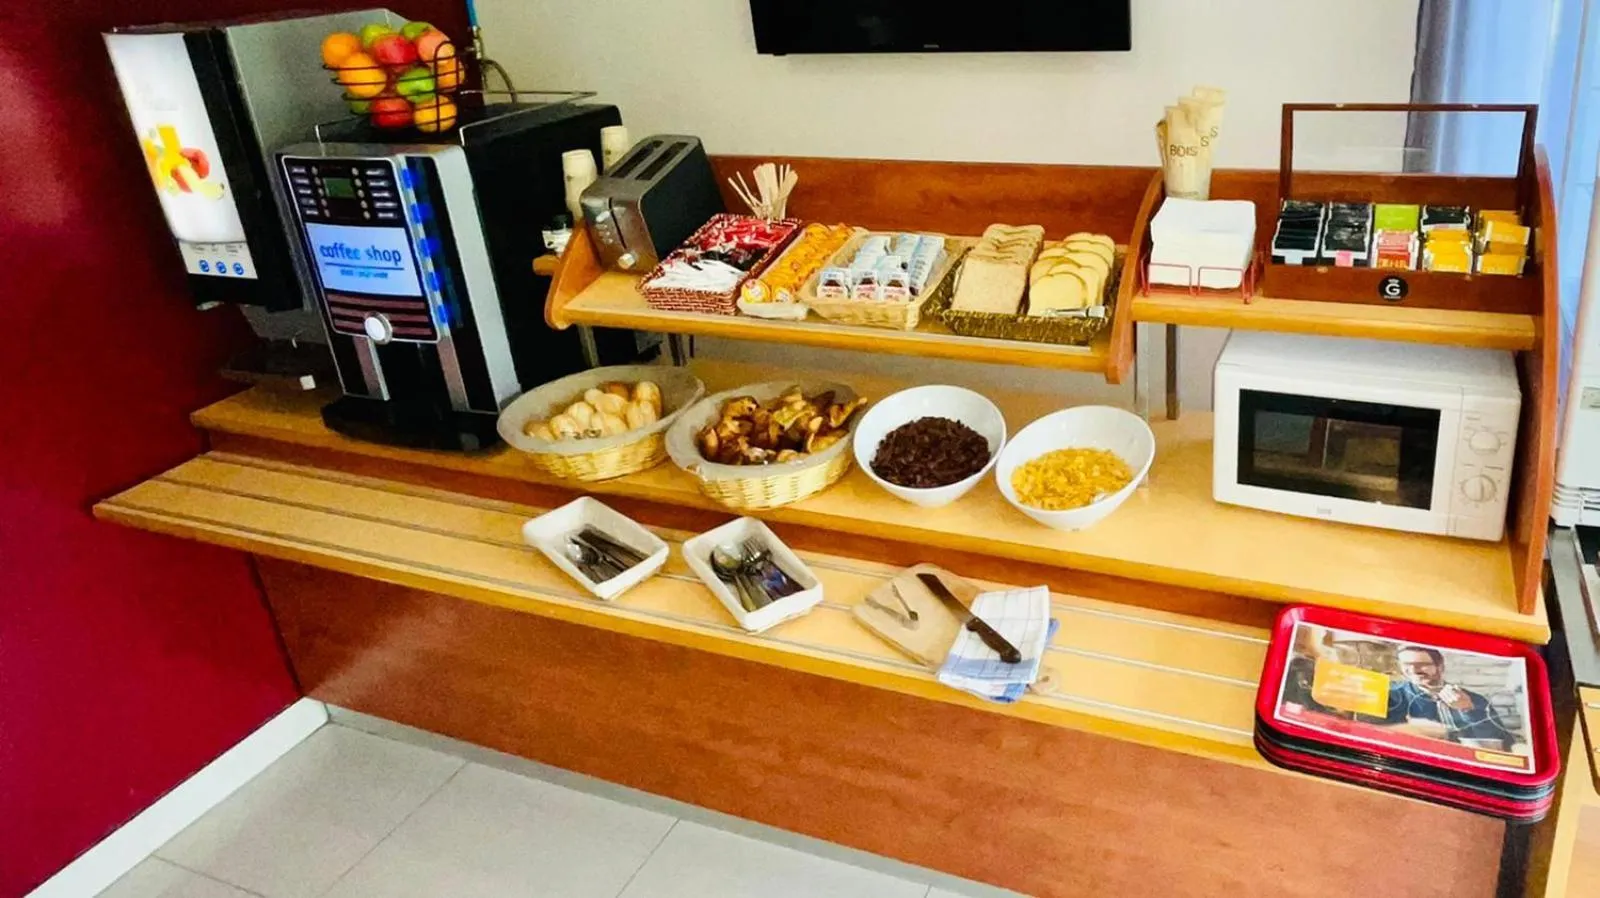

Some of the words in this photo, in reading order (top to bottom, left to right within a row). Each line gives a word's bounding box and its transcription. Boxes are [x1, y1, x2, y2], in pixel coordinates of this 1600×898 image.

[1170, 144, 1198, 157] BOIS
[320, 242, 361, 260] coffee
[364, 244, 402, 266] shop
